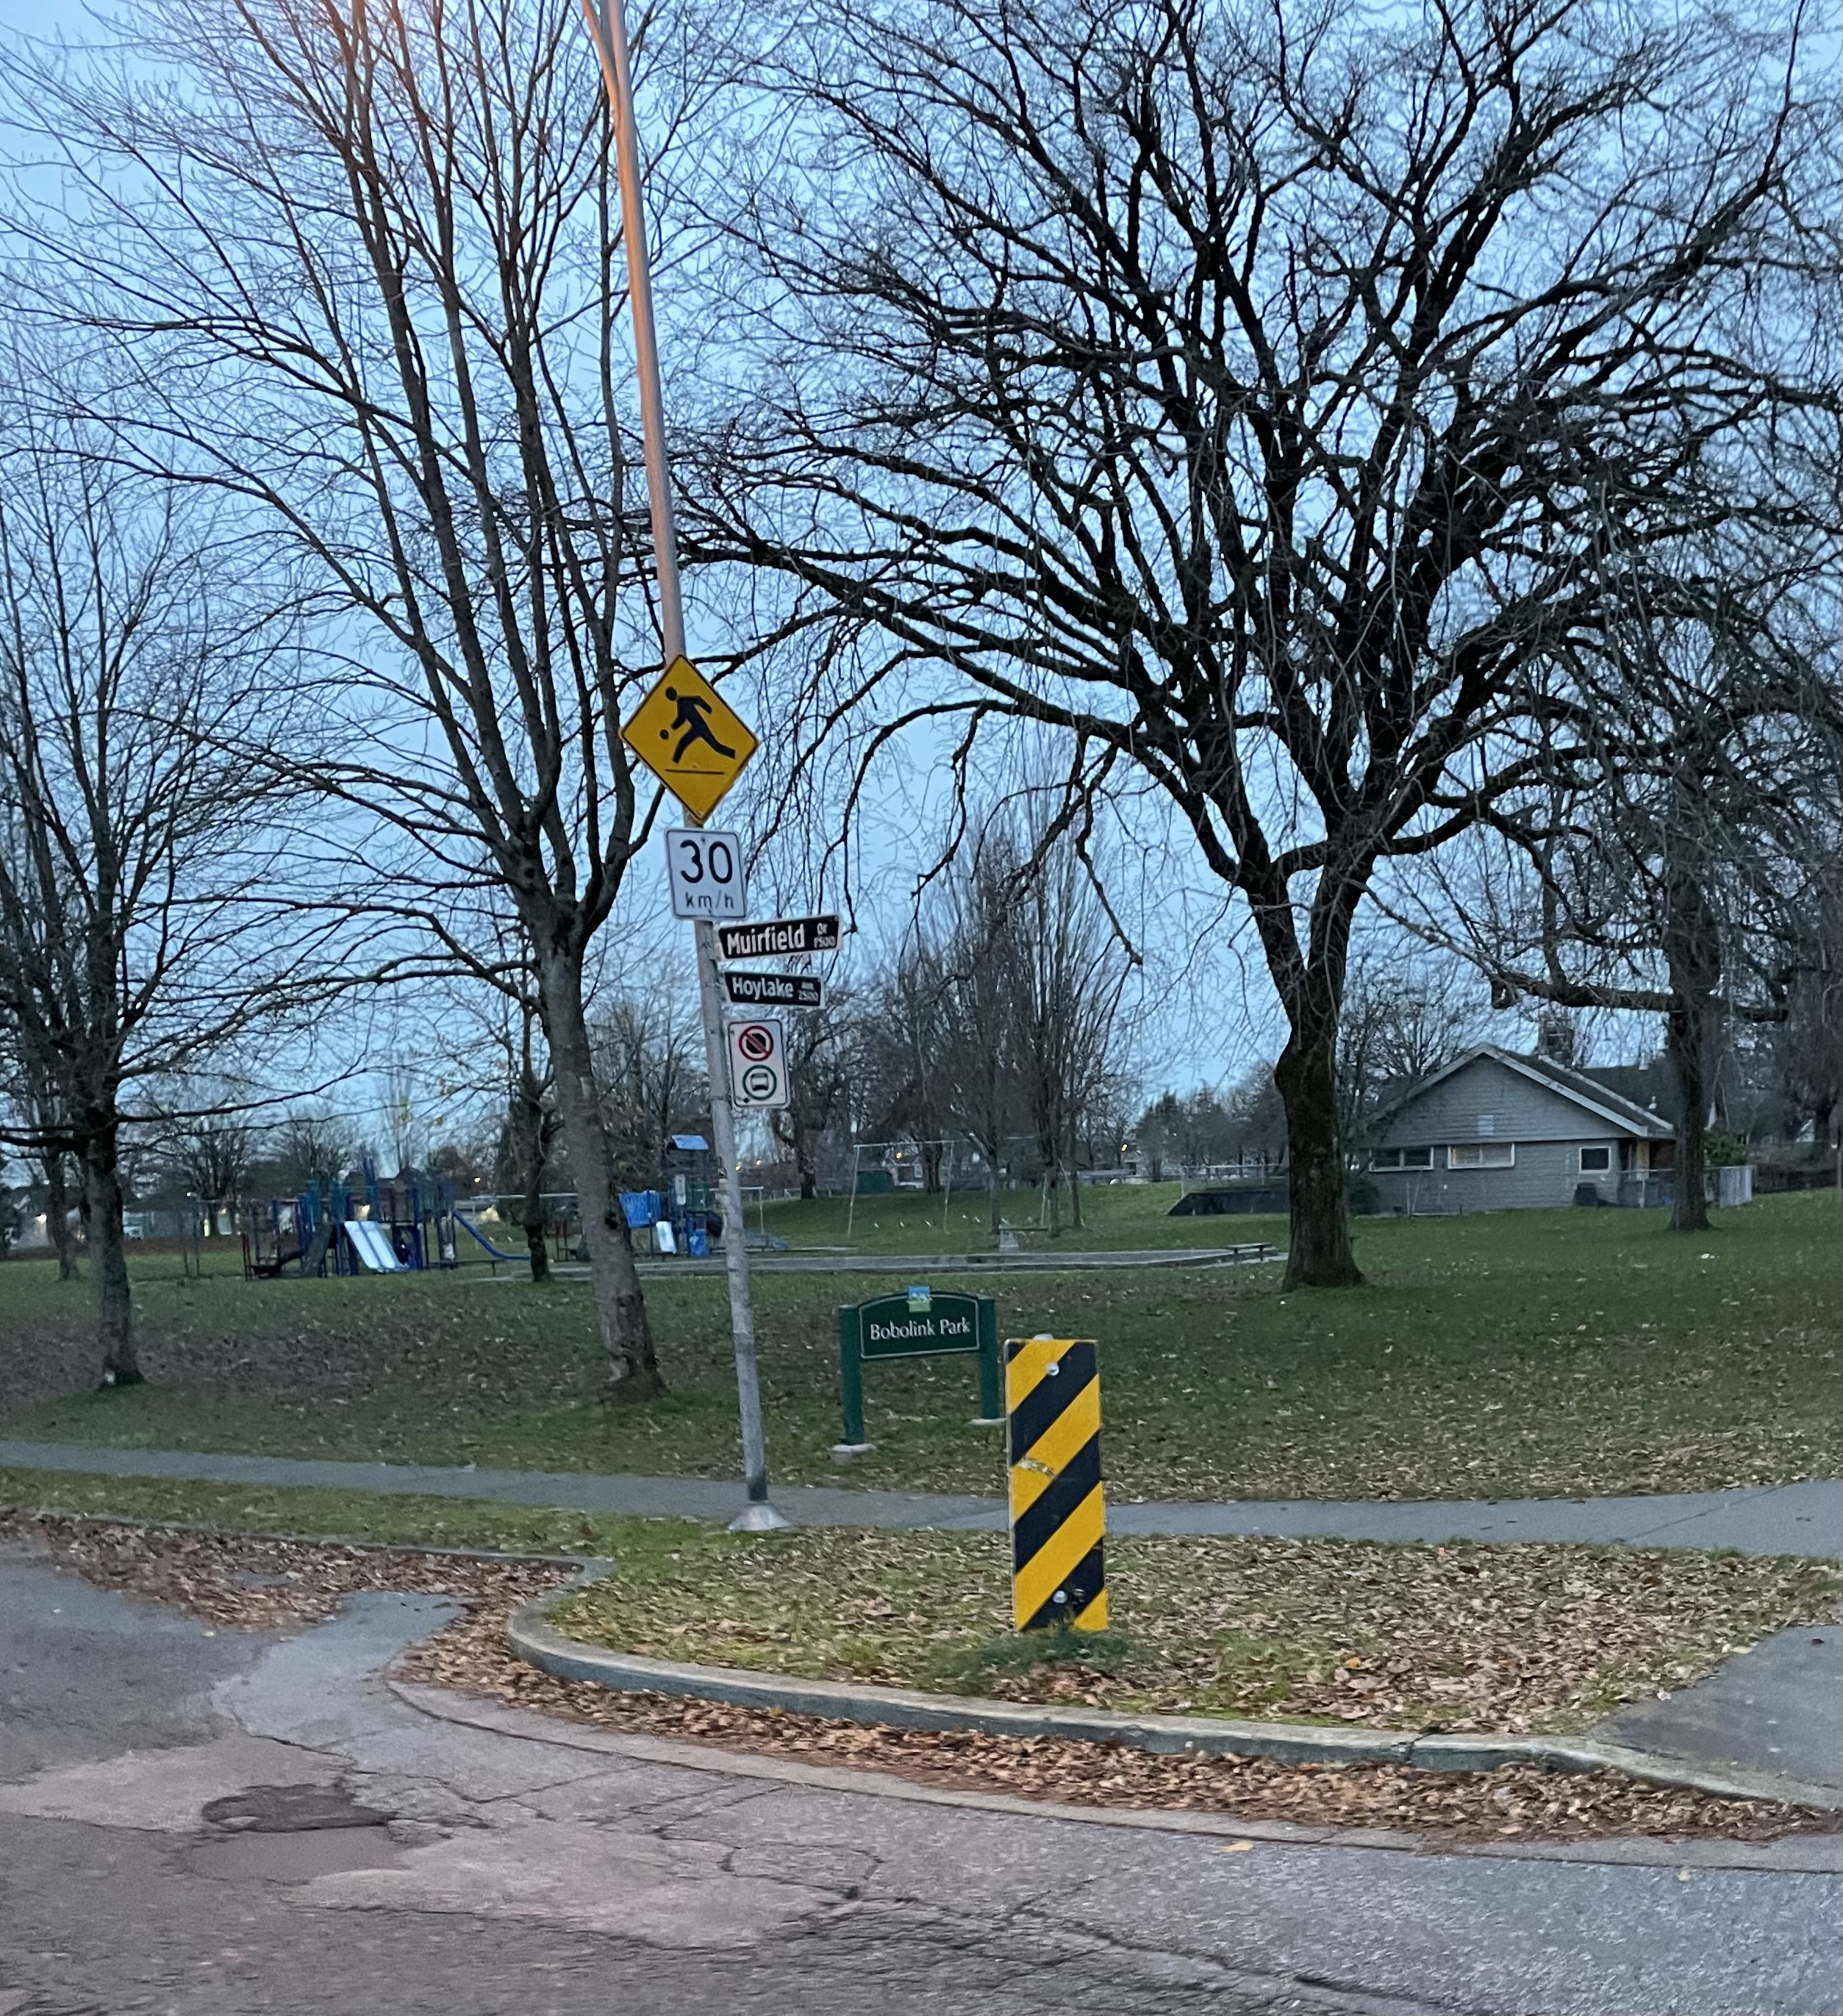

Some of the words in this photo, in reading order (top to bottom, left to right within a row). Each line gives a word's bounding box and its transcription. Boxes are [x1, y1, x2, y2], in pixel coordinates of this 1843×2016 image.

[681, 839, 733, 884] 30
[686, 890, 734, 910] km/h
[727, 923, 805, 955] Muirfield
[732, 976, 794, 1000] Hoylake
[870, 1319, 936, 1341] Bobolink
[940, 1316, 970, 1335] Park
